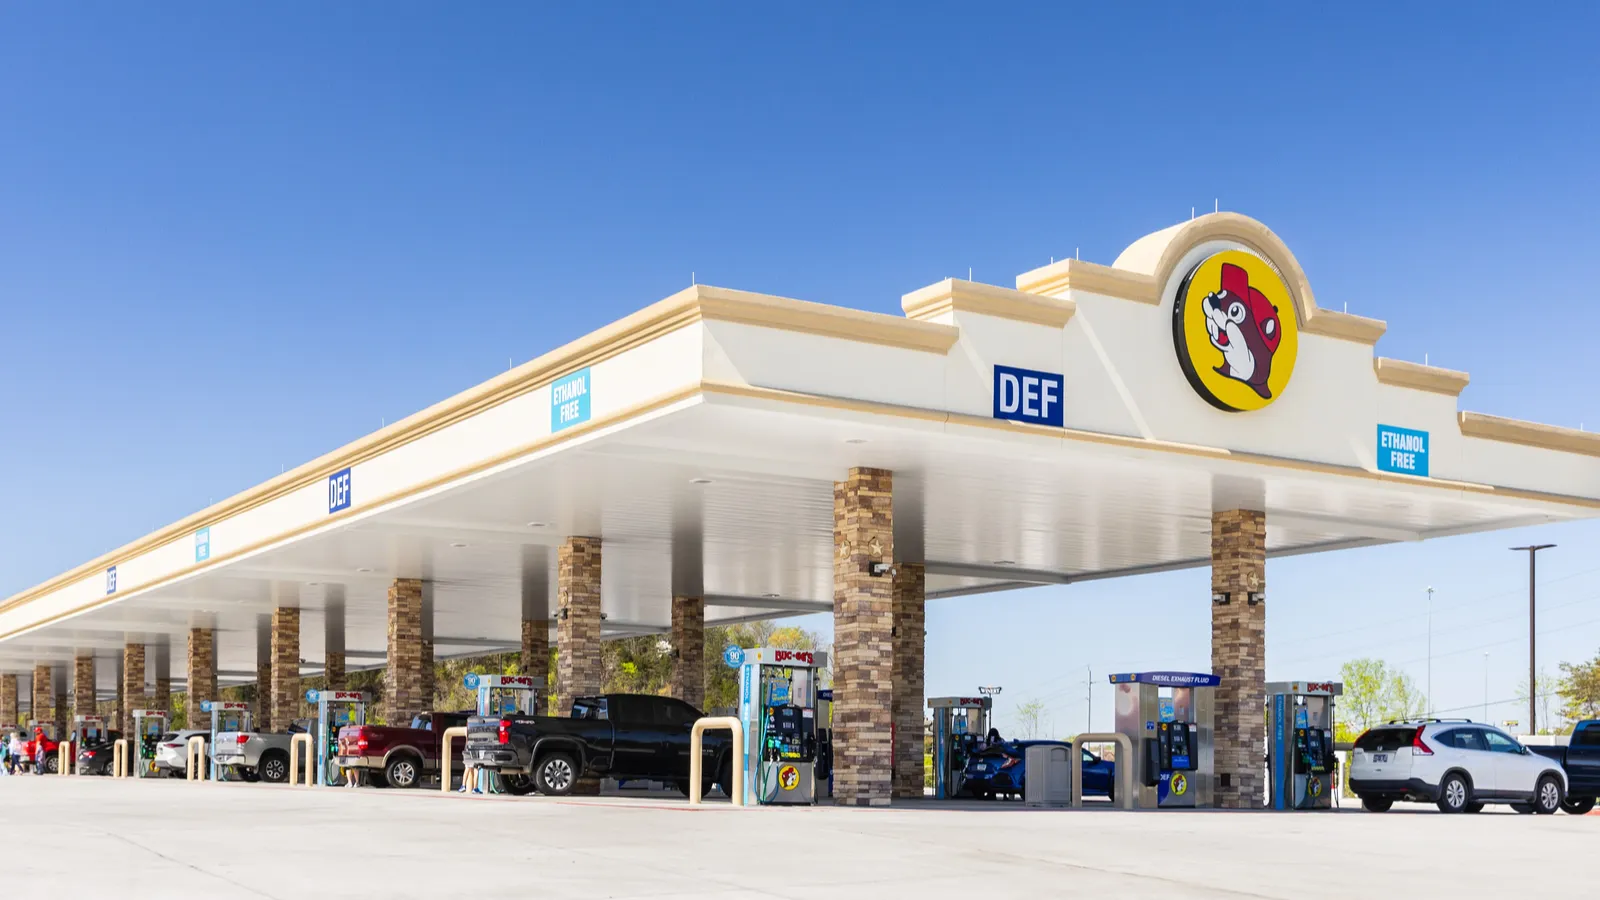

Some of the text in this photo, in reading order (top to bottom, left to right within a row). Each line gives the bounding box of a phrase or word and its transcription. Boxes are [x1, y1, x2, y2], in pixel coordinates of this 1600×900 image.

[553, 375, 587, 406] ETHANOL
[999, 372, 1058, 419] DEF
[560, 400, 580, 424] FREE
[1381, 431, 1426, 454] ETHANOL
[1391, 451, 1416, 470] FREE
[330, 473, 350, 510] DEF
[729, 651, 740, 660] 90
[1152, 674, 1170, 682] DIESEL
[1171, 675, 1194, 683] EXHAUST
